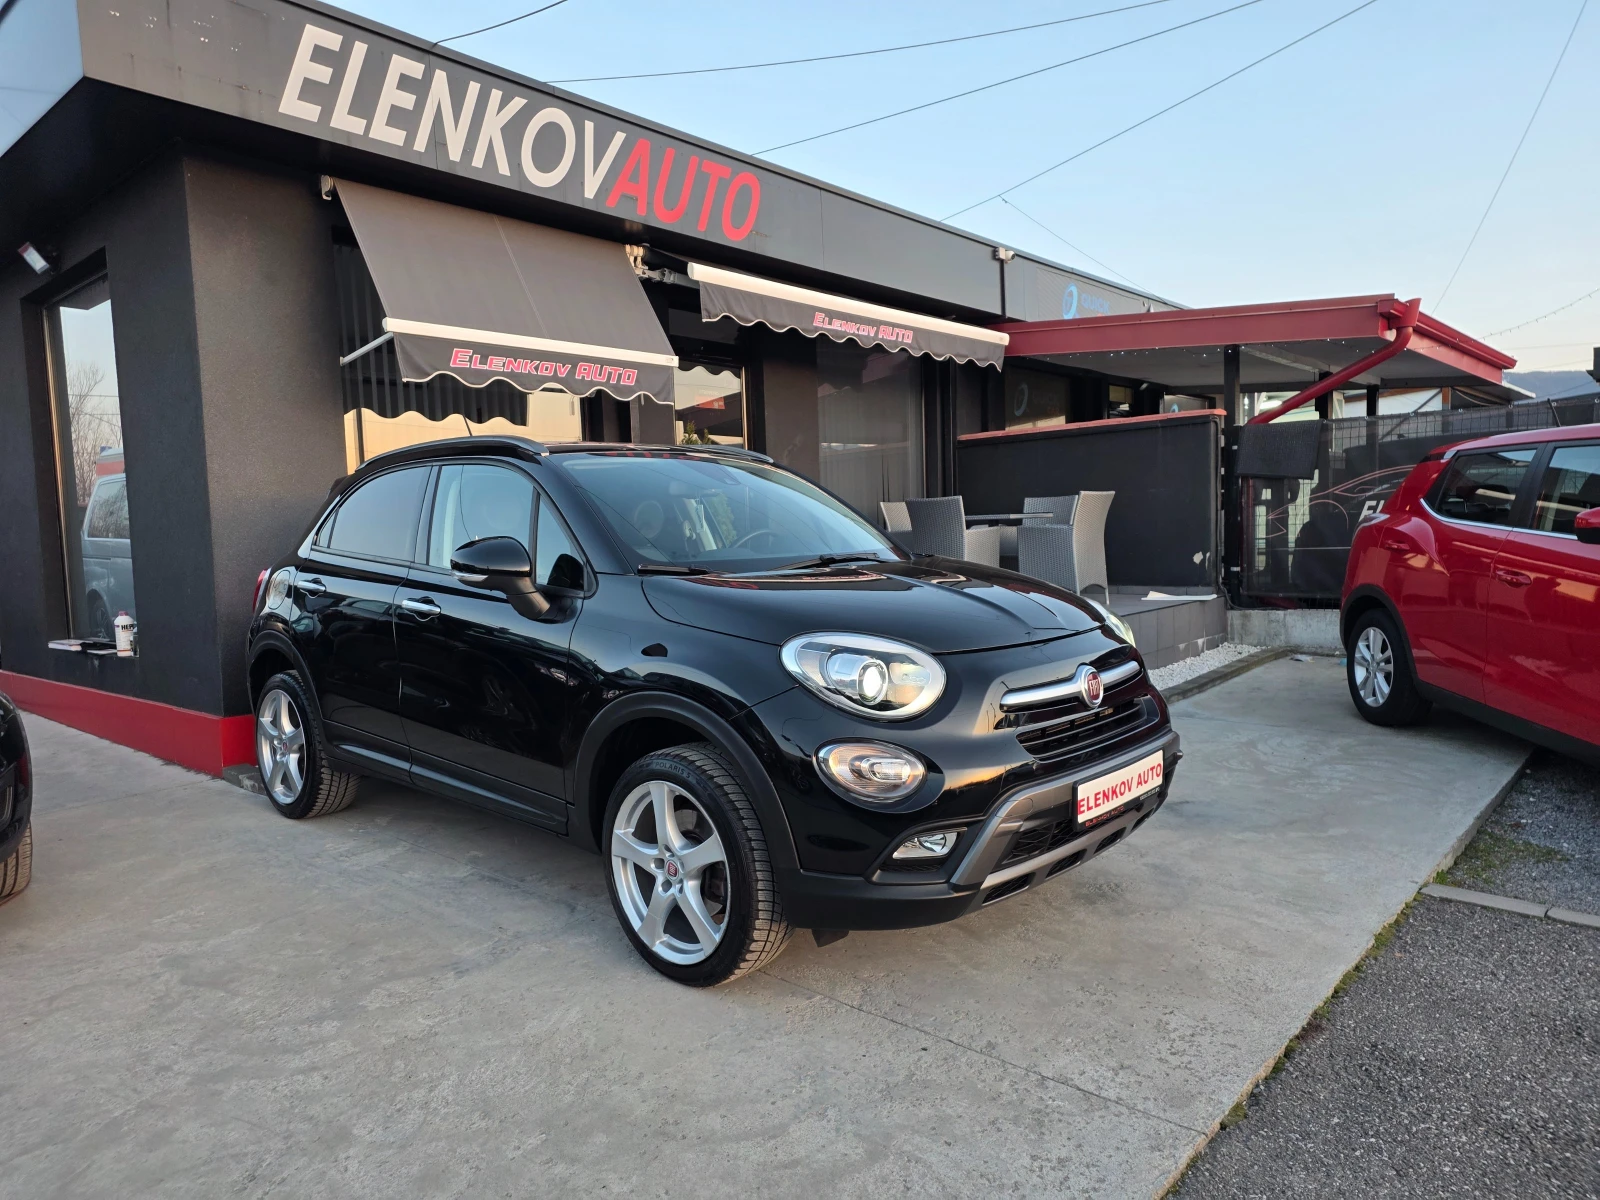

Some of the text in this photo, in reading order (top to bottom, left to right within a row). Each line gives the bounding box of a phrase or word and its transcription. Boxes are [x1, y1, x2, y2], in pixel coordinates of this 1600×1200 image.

[575, 362, 638, 386] AUTO
[655, 761, 685, 775] POLARIS
[1077, 776, 1134, 816] ELENKOV
[1136, 763, 1162, 789] AUTO
